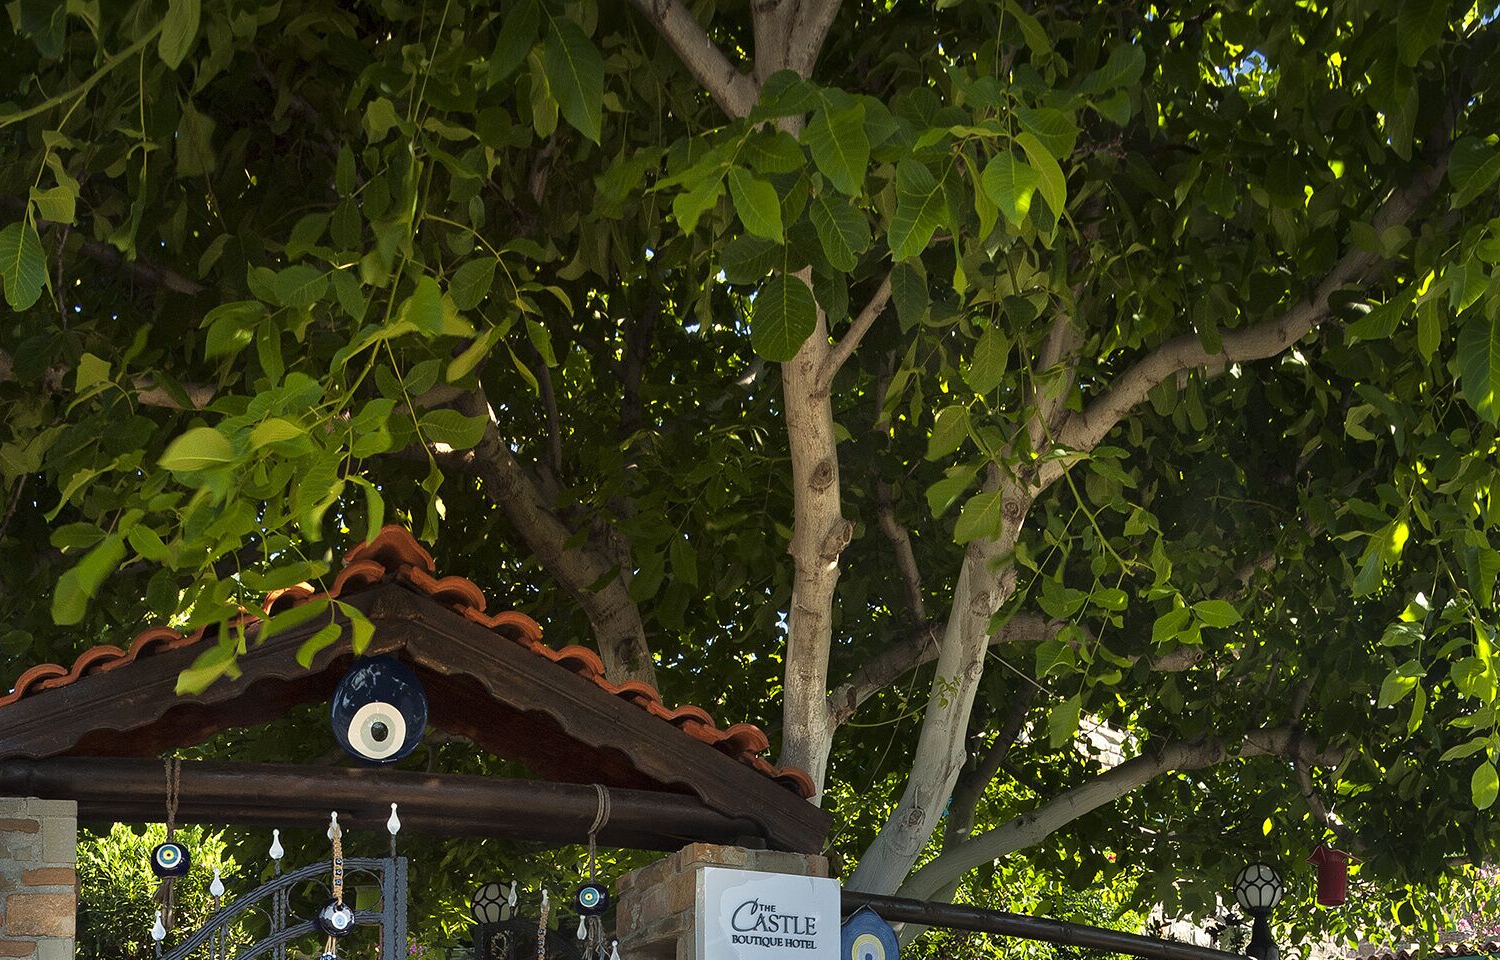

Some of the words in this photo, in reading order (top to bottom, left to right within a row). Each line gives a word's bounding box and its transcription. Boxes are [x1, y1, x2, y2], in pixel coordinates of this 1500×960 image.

[731, 897, 817, 936] CASTLE
[759, 904, 776, 913] THE
[731, 934, 784, 948] BOUTIQUE
[785, 938, 817, 950] HOTEL
